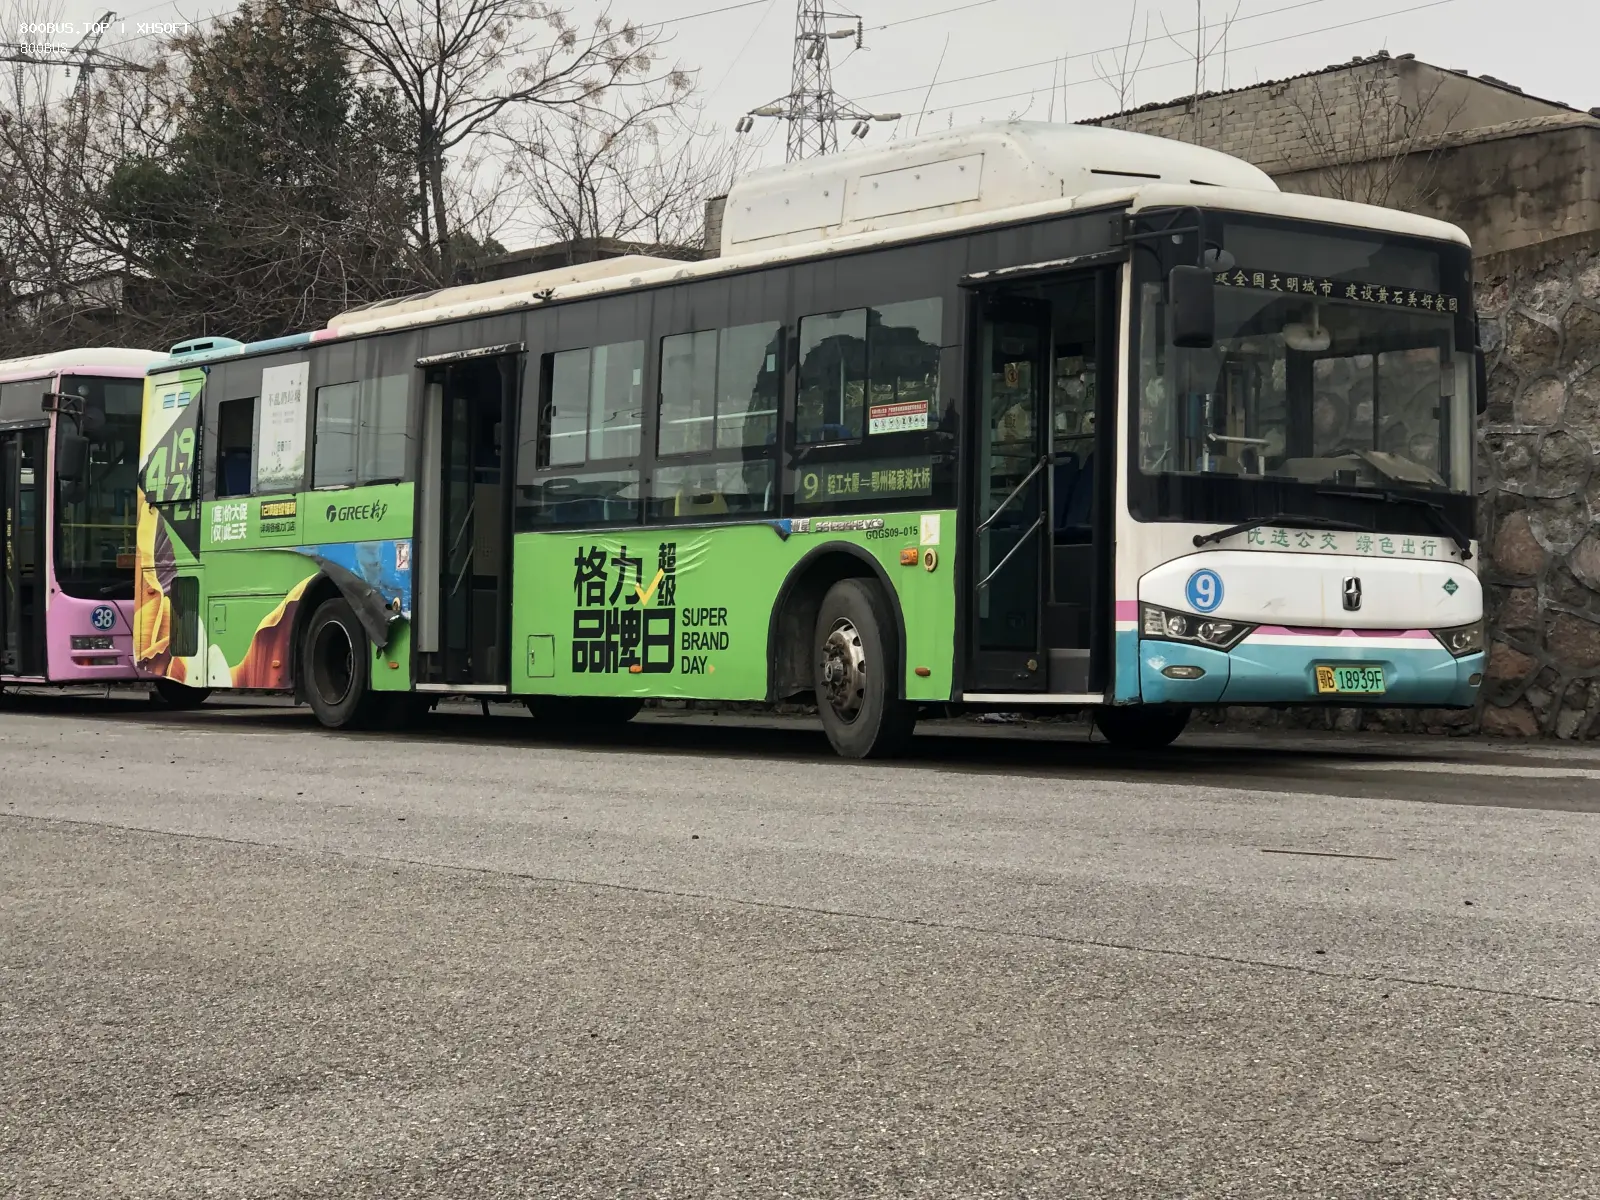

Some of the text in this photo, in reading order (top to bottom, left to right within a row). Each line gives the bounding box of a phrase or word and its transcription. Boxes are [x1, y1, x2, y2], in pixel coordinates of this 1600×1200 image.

[1345, 283, 1458, 313] 建设黄石美好家园
[803, 473, 819, 500] 9
[338, 504, 370, 521] GREE
[865, 526, 918, 540] GQGS09-015
[1247, 527, 1438, 557] 优选公交 绿色出行
[573, 545, 643, 607] 格力
[657, 542, 677, 607] 超级
[1195, 574, 1216, 608] 9
[94, 608, 113, 628] 38
[681, 607, 728, 626] SUPER
[572, 606, 676, 673] 品牌日
[681, 631, 730, 651] BRAND
[681, 655, 708, 675] DAY
